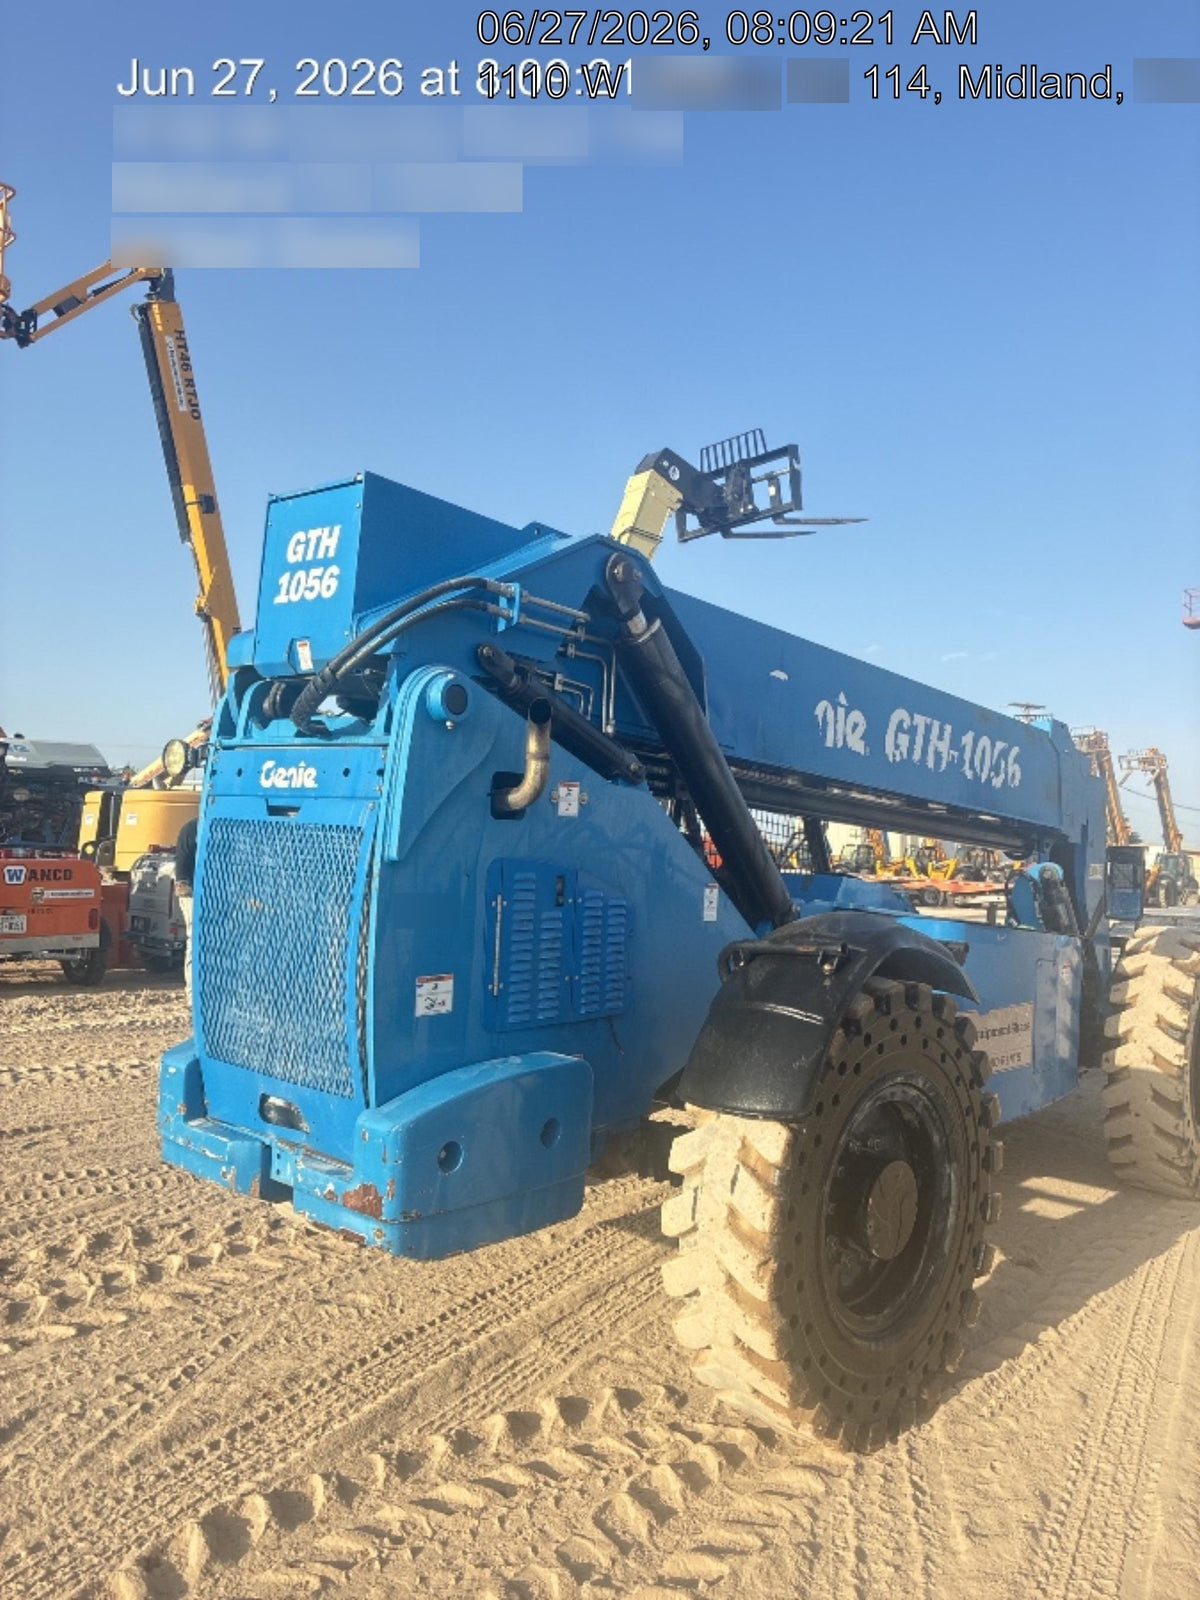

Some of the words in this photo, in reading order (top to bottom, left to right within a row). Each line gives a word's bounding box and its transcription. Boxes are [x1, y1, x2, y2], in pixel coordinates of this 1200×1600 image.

[174, 329, 193, 372] HT46
[285, 524, 342, 565] GTH
[273, 565, 341, 605] 1056
[885, 707, 1022, 789] GTH-1056
[260, 760, 319, 788] Genie
[4, 866, 73, 884] WANCO
